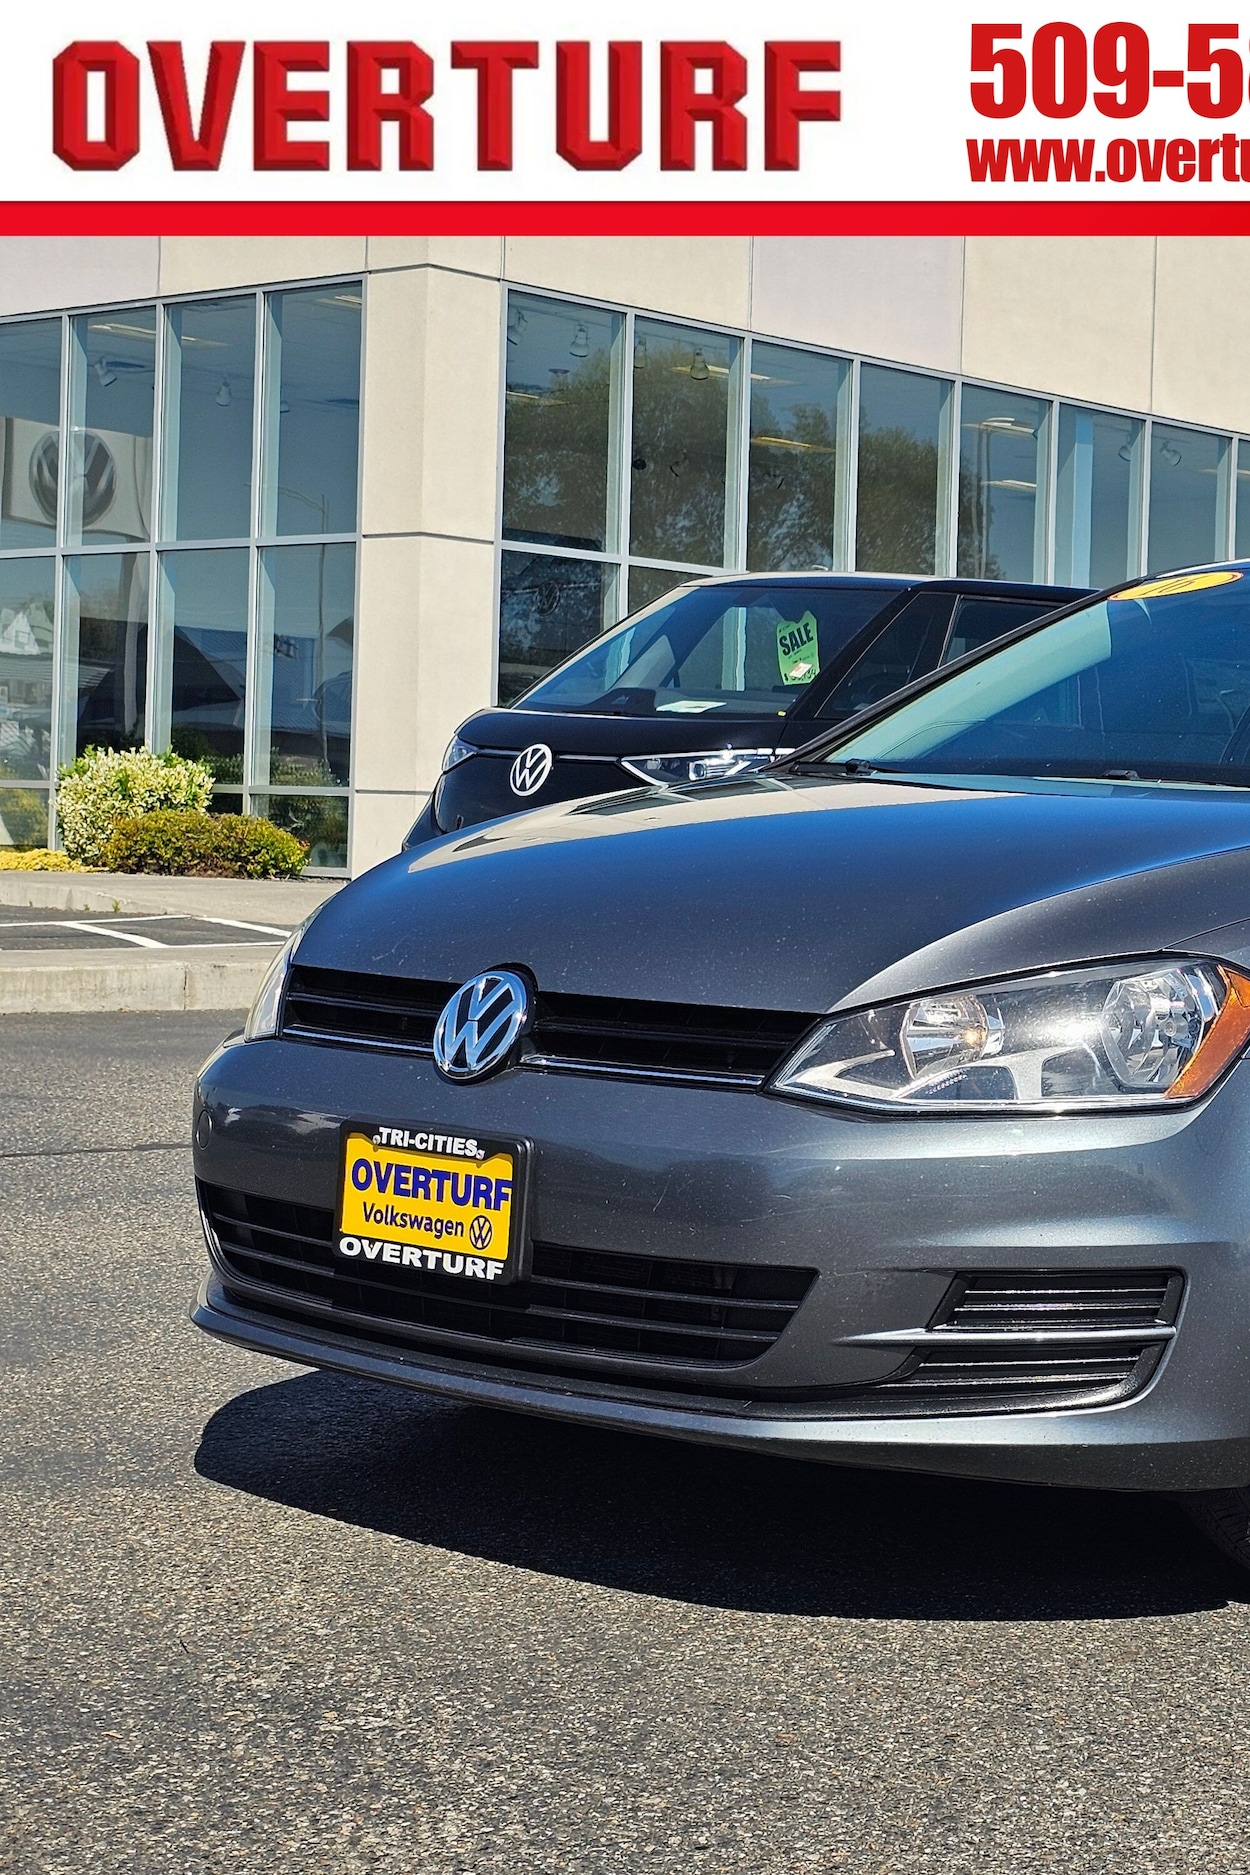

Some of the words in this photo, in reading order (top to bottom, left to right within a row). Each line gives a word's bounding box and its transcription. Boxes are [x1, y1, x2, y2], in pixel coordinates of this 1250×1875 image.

[779, 622, 814, 656] SALE
[379, 1126, 478, 1158] TRI-CITIES
[351, 1158, 513, 1211] OVERTURF
[363, 1201, 464, 1239] Volkswagen
[339, 1237, 505, 1281] OVERTURF
